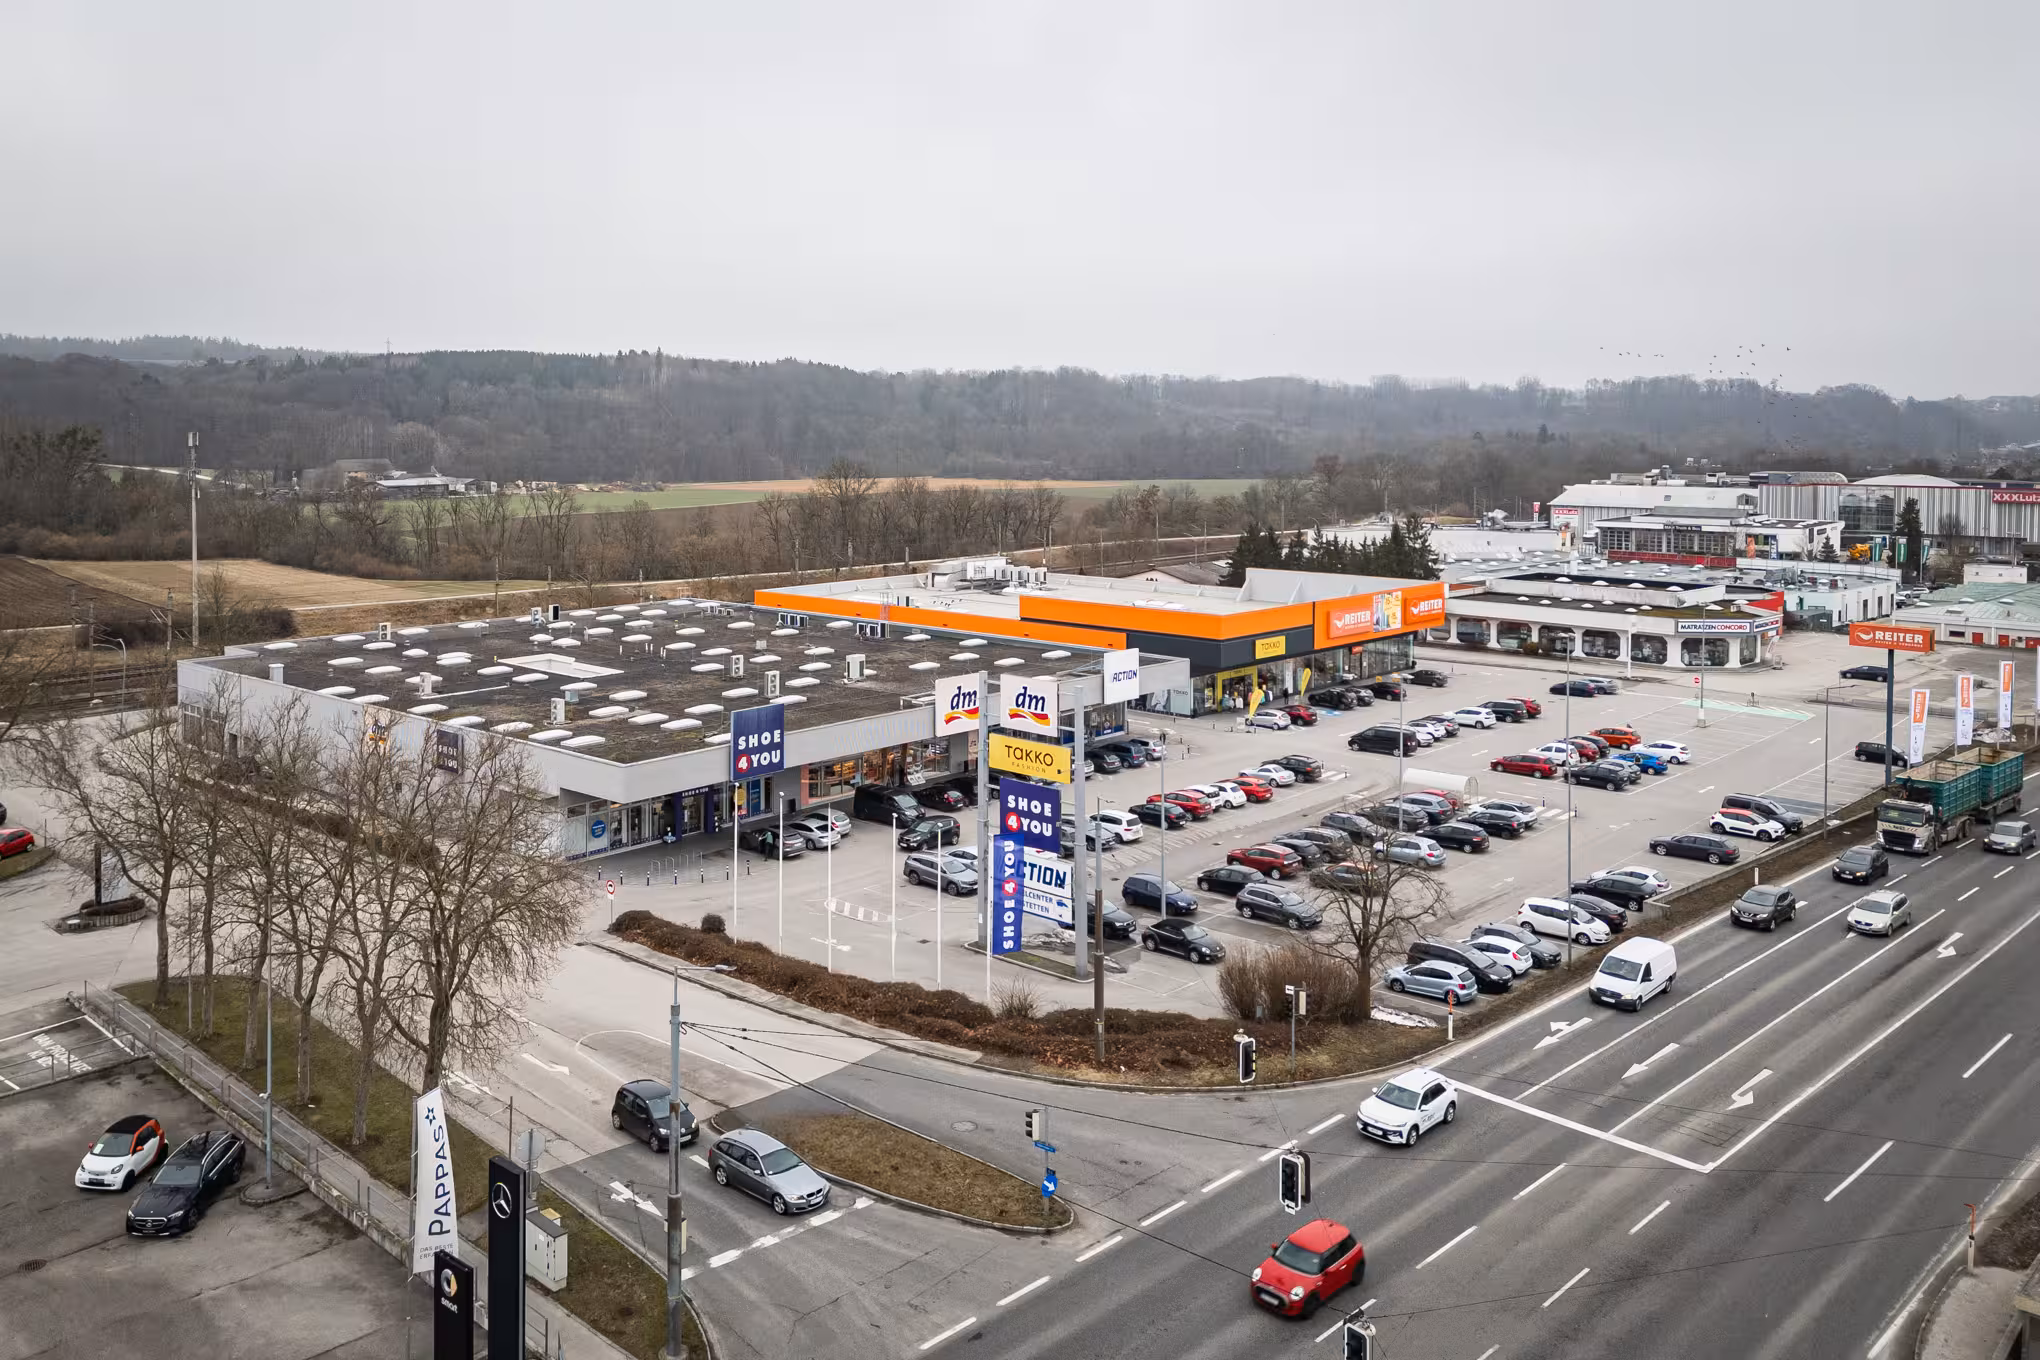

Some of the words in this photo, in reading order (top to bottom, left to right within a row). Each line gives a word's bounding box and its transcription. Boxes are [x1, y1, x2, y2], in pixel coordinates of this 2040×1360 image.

[1420, 599, 1442, 612] REITER
[1344, 610, 1371, 625] REITER
[1875, 630, 1923, 644] REITER
[1112, 669, 1138, 683] ACTION
[950, 686, 977, 711] dm
[1015, 686, 1046, 712] dm
[737, 729, 781, 750] SHOE
[1011, 761, 1046, 774] FASHION
[1007, 795, 1052, 817] SHOE
[1002, 899, 1015, 950] SHOE
[428, 1124, 451, 1237] PAPPAS
[420, 1245, 433, 1253] DAS
[441, 1296, 458, 1314] smart
